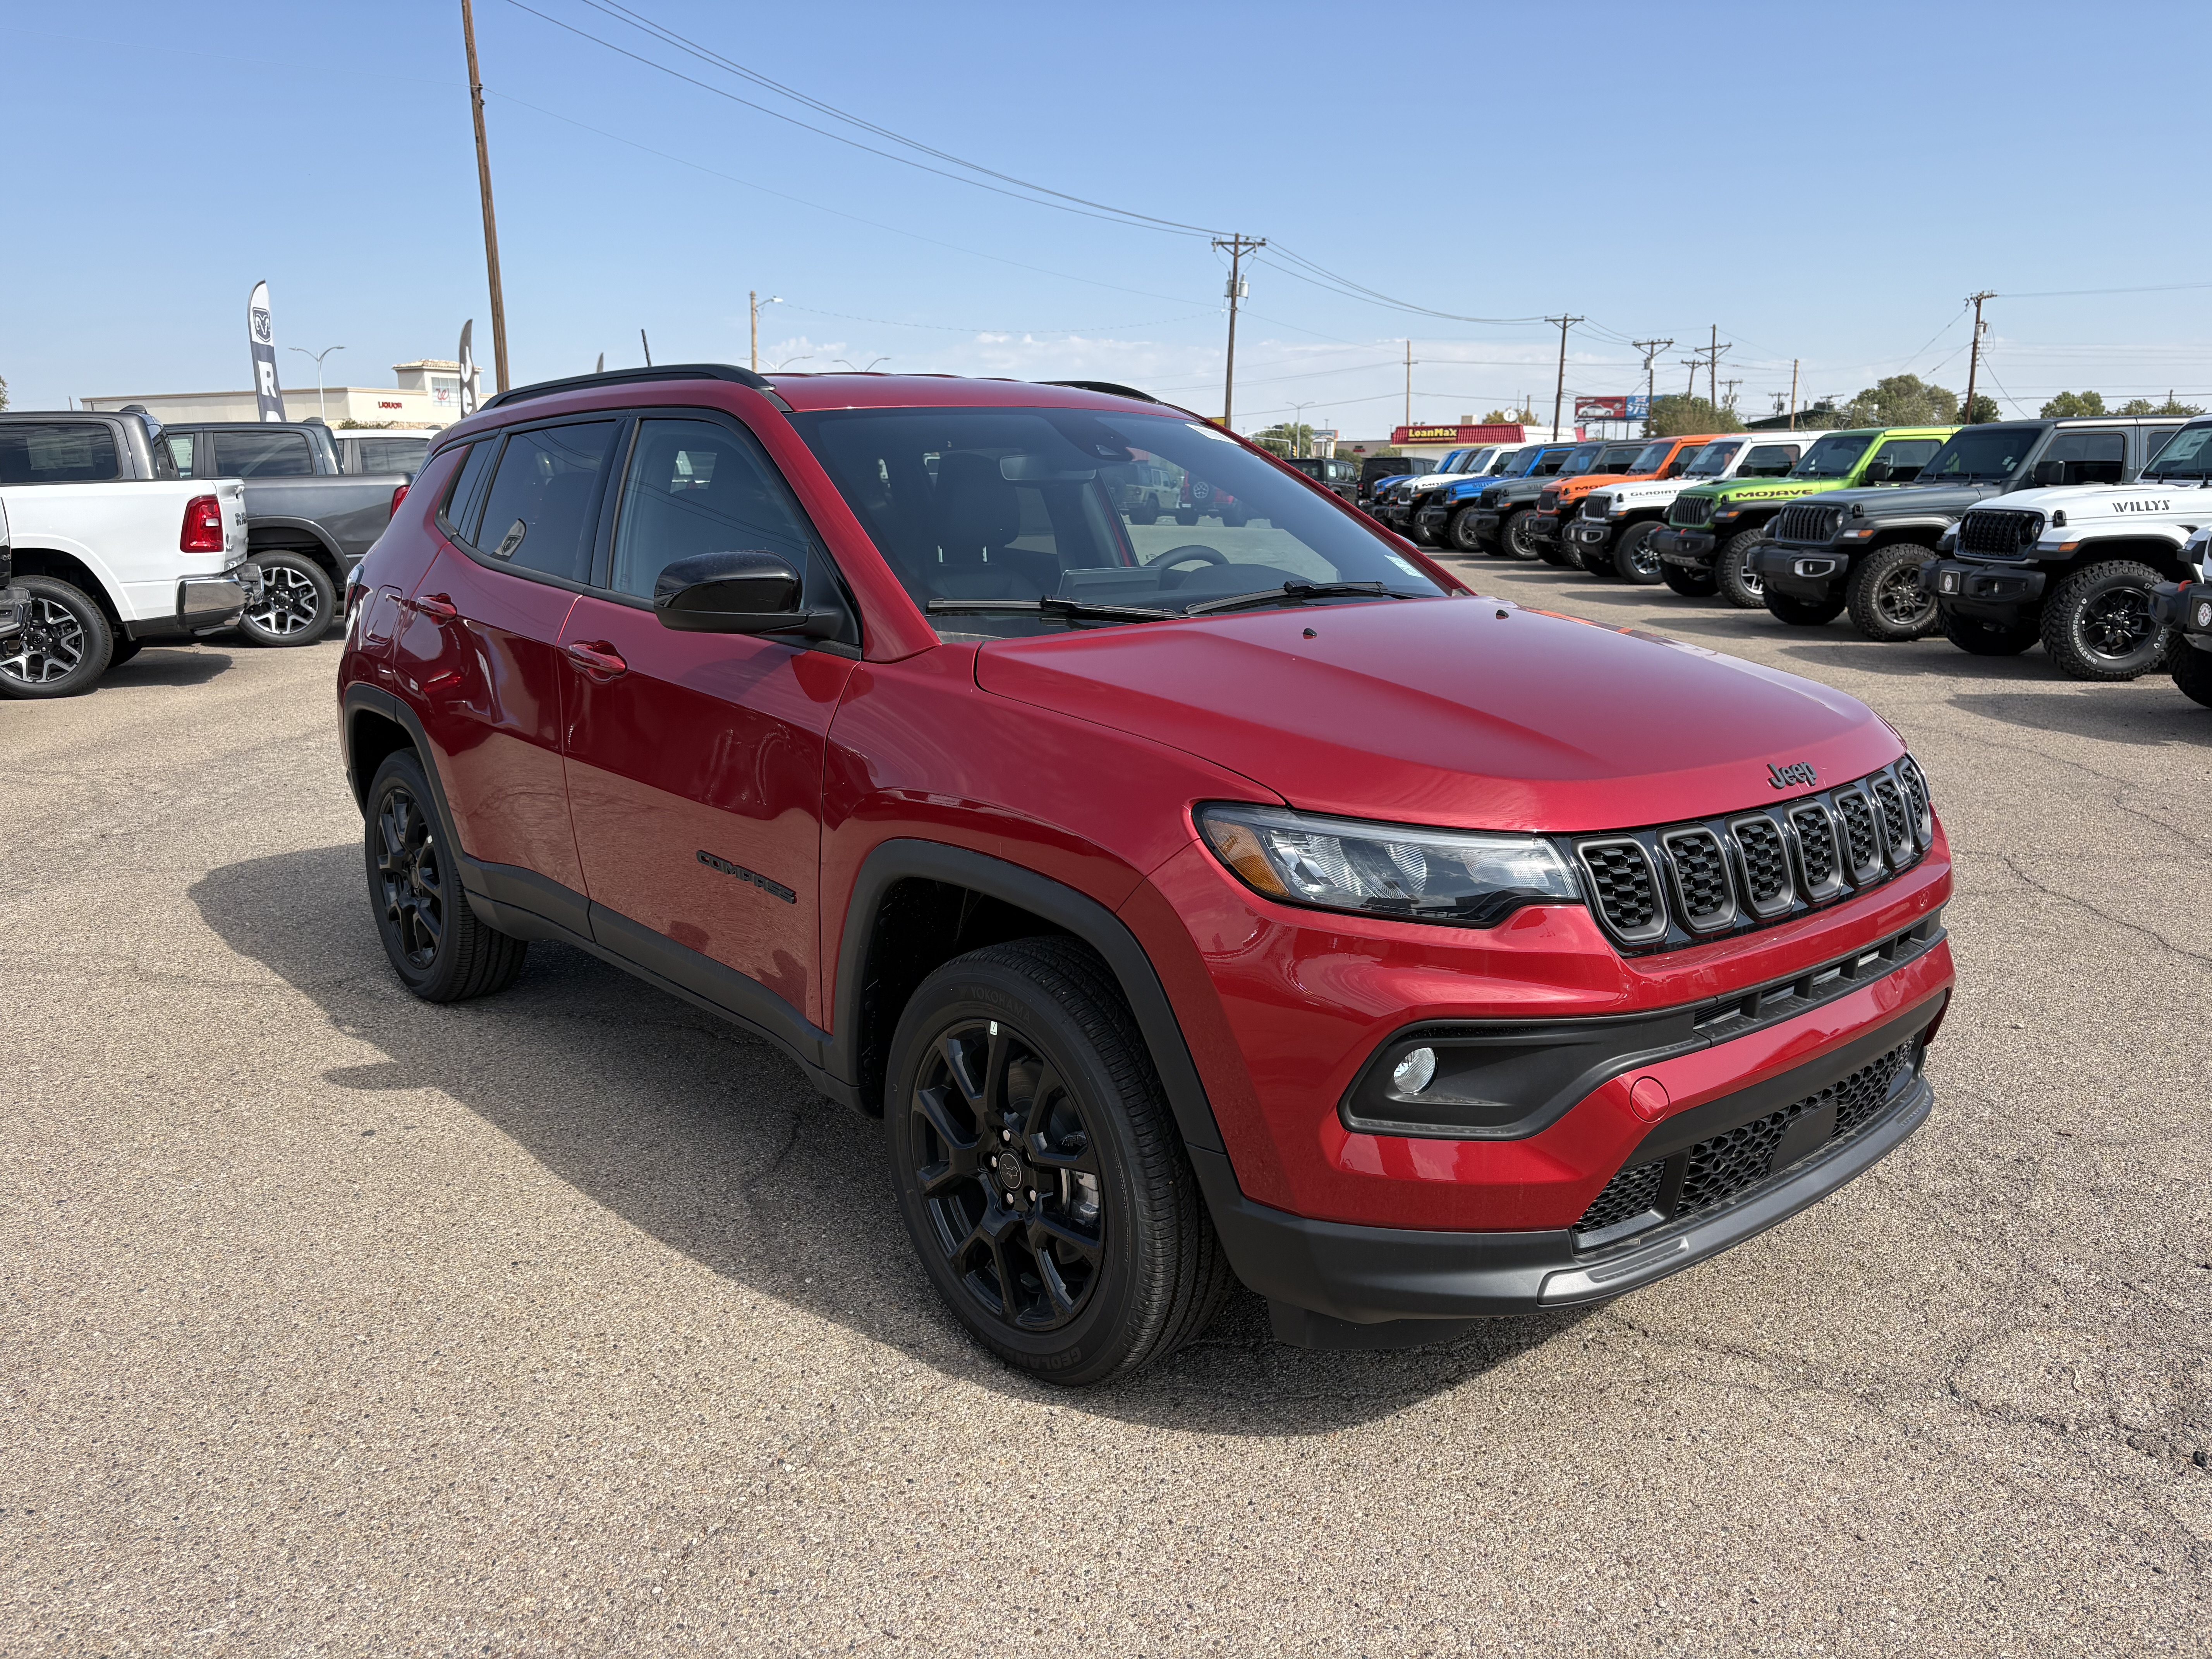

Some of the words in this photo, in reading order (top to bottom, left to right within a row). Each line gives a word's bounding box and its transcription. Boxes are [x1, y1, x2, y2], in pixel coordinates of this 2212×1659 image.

[378, 401, 402, 409] LIQUOR
[1736, 489, 1814, 498] MOJAVE
[2112, 500, 2170, 513] WILLYS
[235, 512, 247, 526] RA
[2073, 605, 2098, 665] DESTINATION
[1767, 762, 1817, 790] Jeep
[696, 850, 797, 904] COMPASS
[970, 986, 1030, 1024] YOKOHAMA
